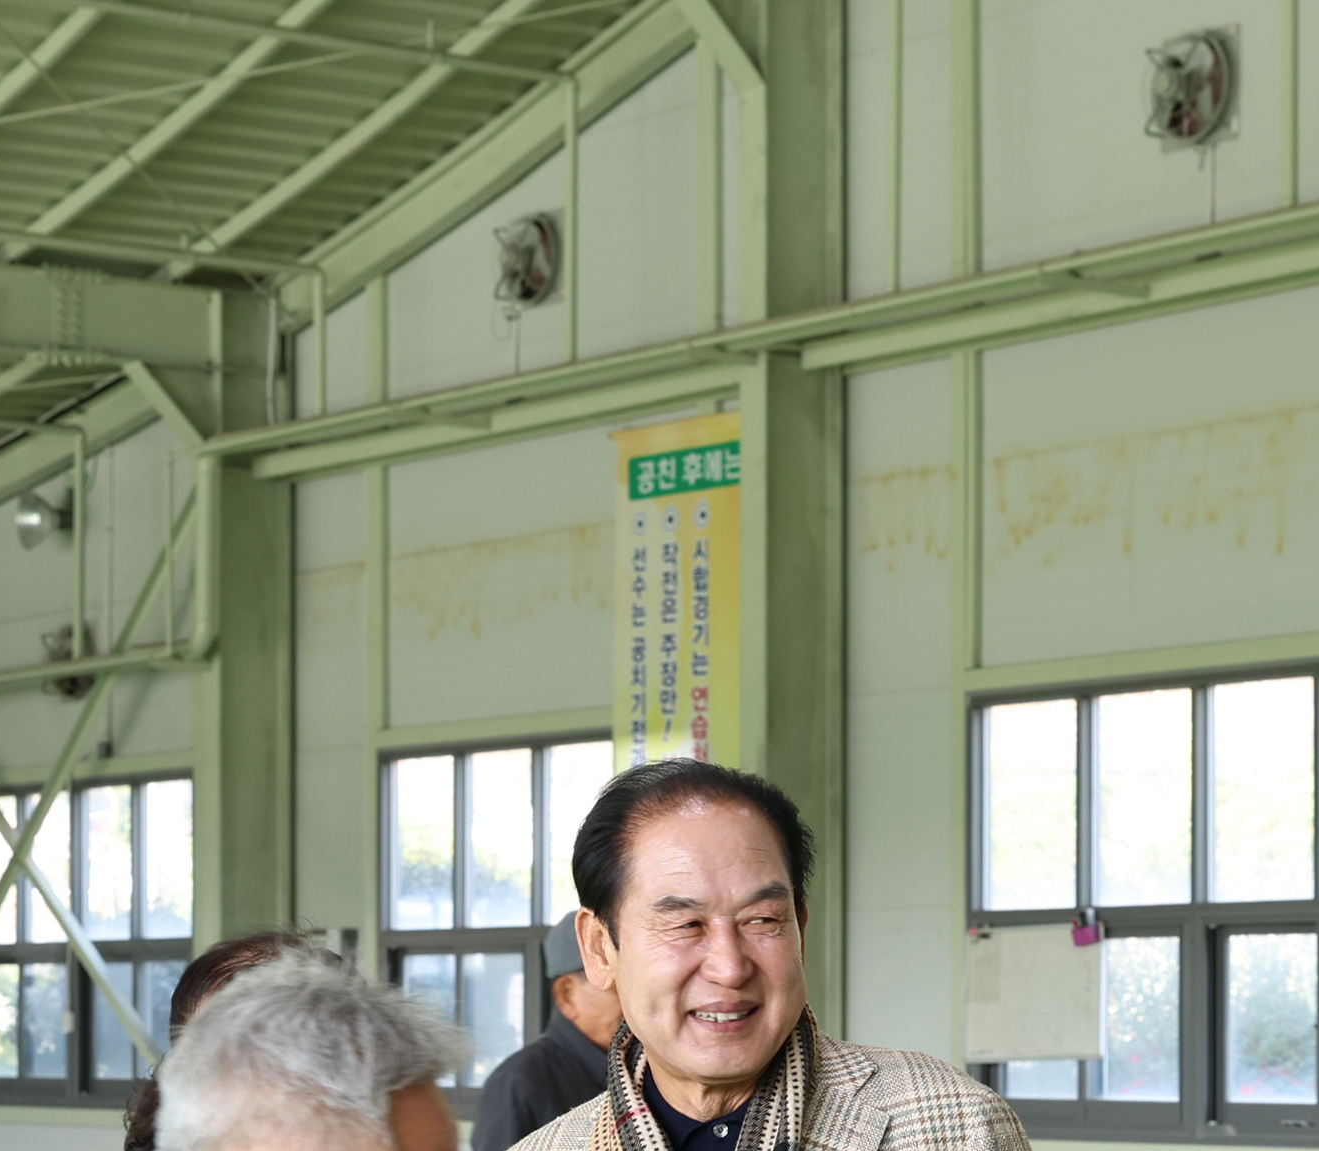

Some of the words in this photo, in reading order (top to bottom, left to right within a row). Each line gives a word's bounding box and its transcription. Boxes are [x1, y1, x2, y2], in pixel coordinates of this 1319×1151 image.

[631, 546, 647, 628] 선수는
[662, 542, 679, 623] 작전은
[692, 539, 710, 677] 시합경기는
[660, 633, 678, 742] 주장만!
